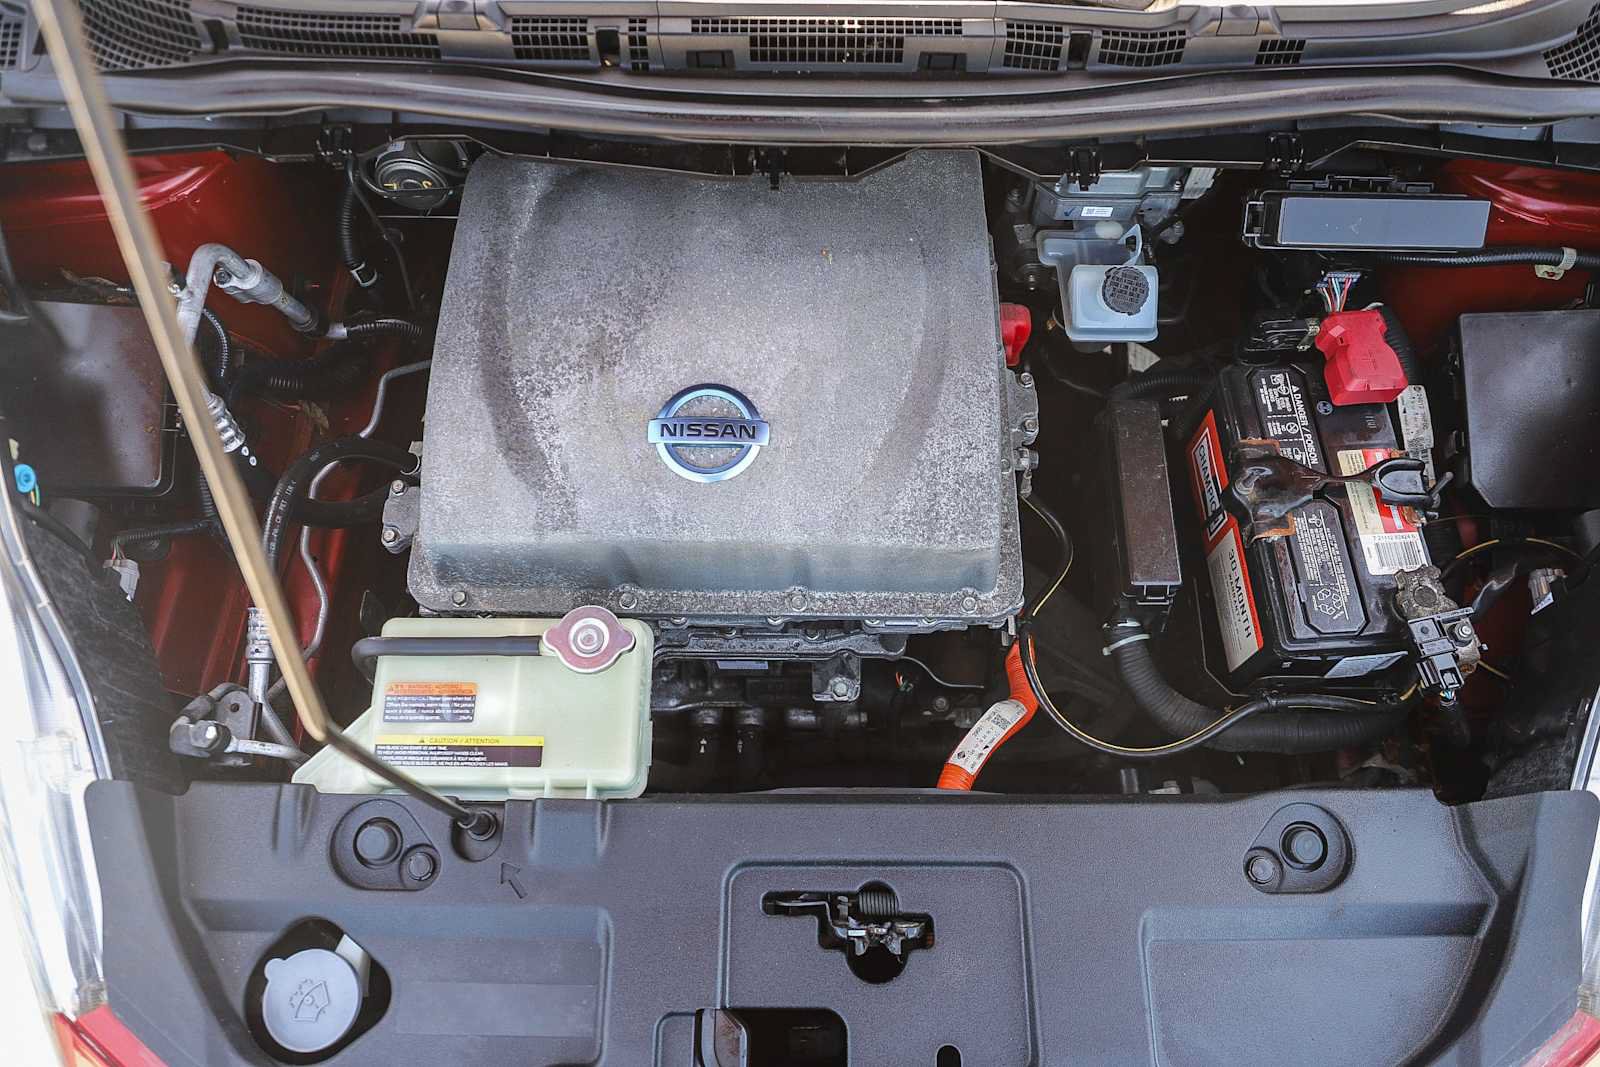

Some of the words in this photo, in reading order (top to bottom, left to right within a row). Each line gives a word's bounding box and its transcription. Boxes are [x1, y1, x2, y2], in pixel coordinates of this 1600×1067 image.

[660, 423, 757, 439] NISSAN
[1294, 394, 1308, 425] DANGER
[1304, 434, 1318, 464] POISON
[1198, 443, 1220, 521] CHAMPIO
[1228, 548, 1252, 638] 30-MONTH
